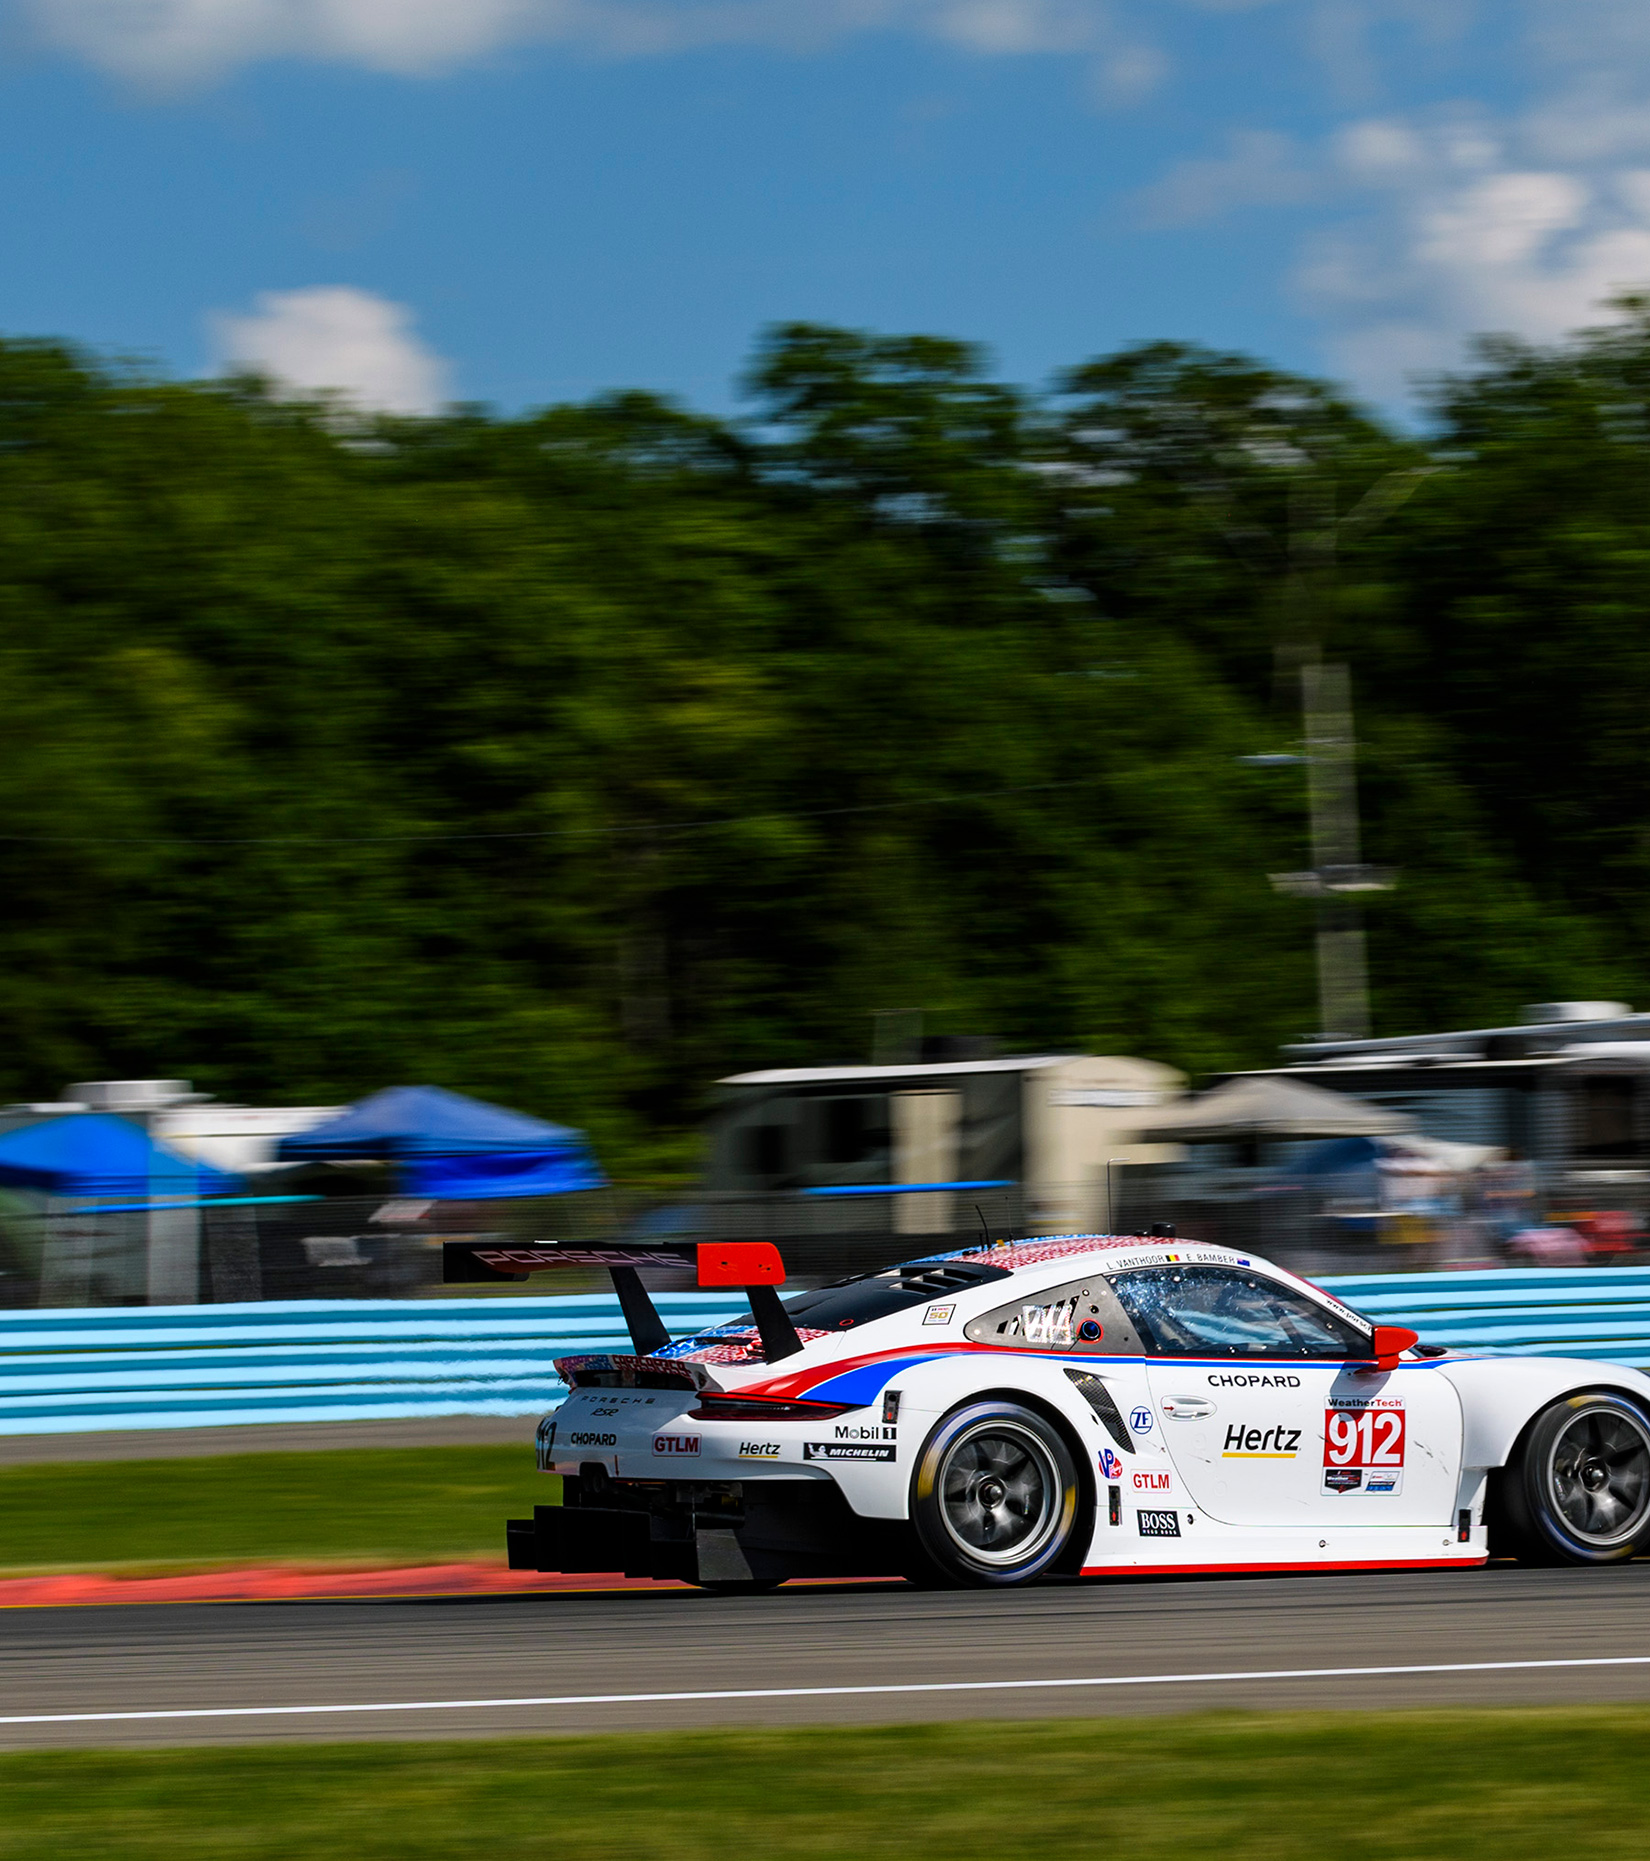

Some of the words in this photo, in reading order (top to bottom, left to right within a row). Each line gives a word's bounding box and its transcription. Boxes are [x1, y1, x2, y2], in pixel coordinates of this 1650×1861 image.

[471, 1250, 697, 1268] PORSCHE
[1207, 1375, 1301, 1388] CHOPARD
[1328, 1398, 1402, 1407] WeatherTech
[570, 1432, 617, 1446] CHOPARD
[834, 1425, 879, 1440] Mobil
[1223, 1424, 1302, 1451] Hertz
[1328, 1411, 1403, 1465] 912
[654, 1437, 699, 1453] GTLM
[738, 1442, 780, 1455] Hertz
[829, 1448, 890, 1457] MICHELIN
[1098, 1448, 1114, 1479] VP
[1133, 1473, 1170, 1489] GTLM
[1141, 1512, 1176, 1530] BOSS
